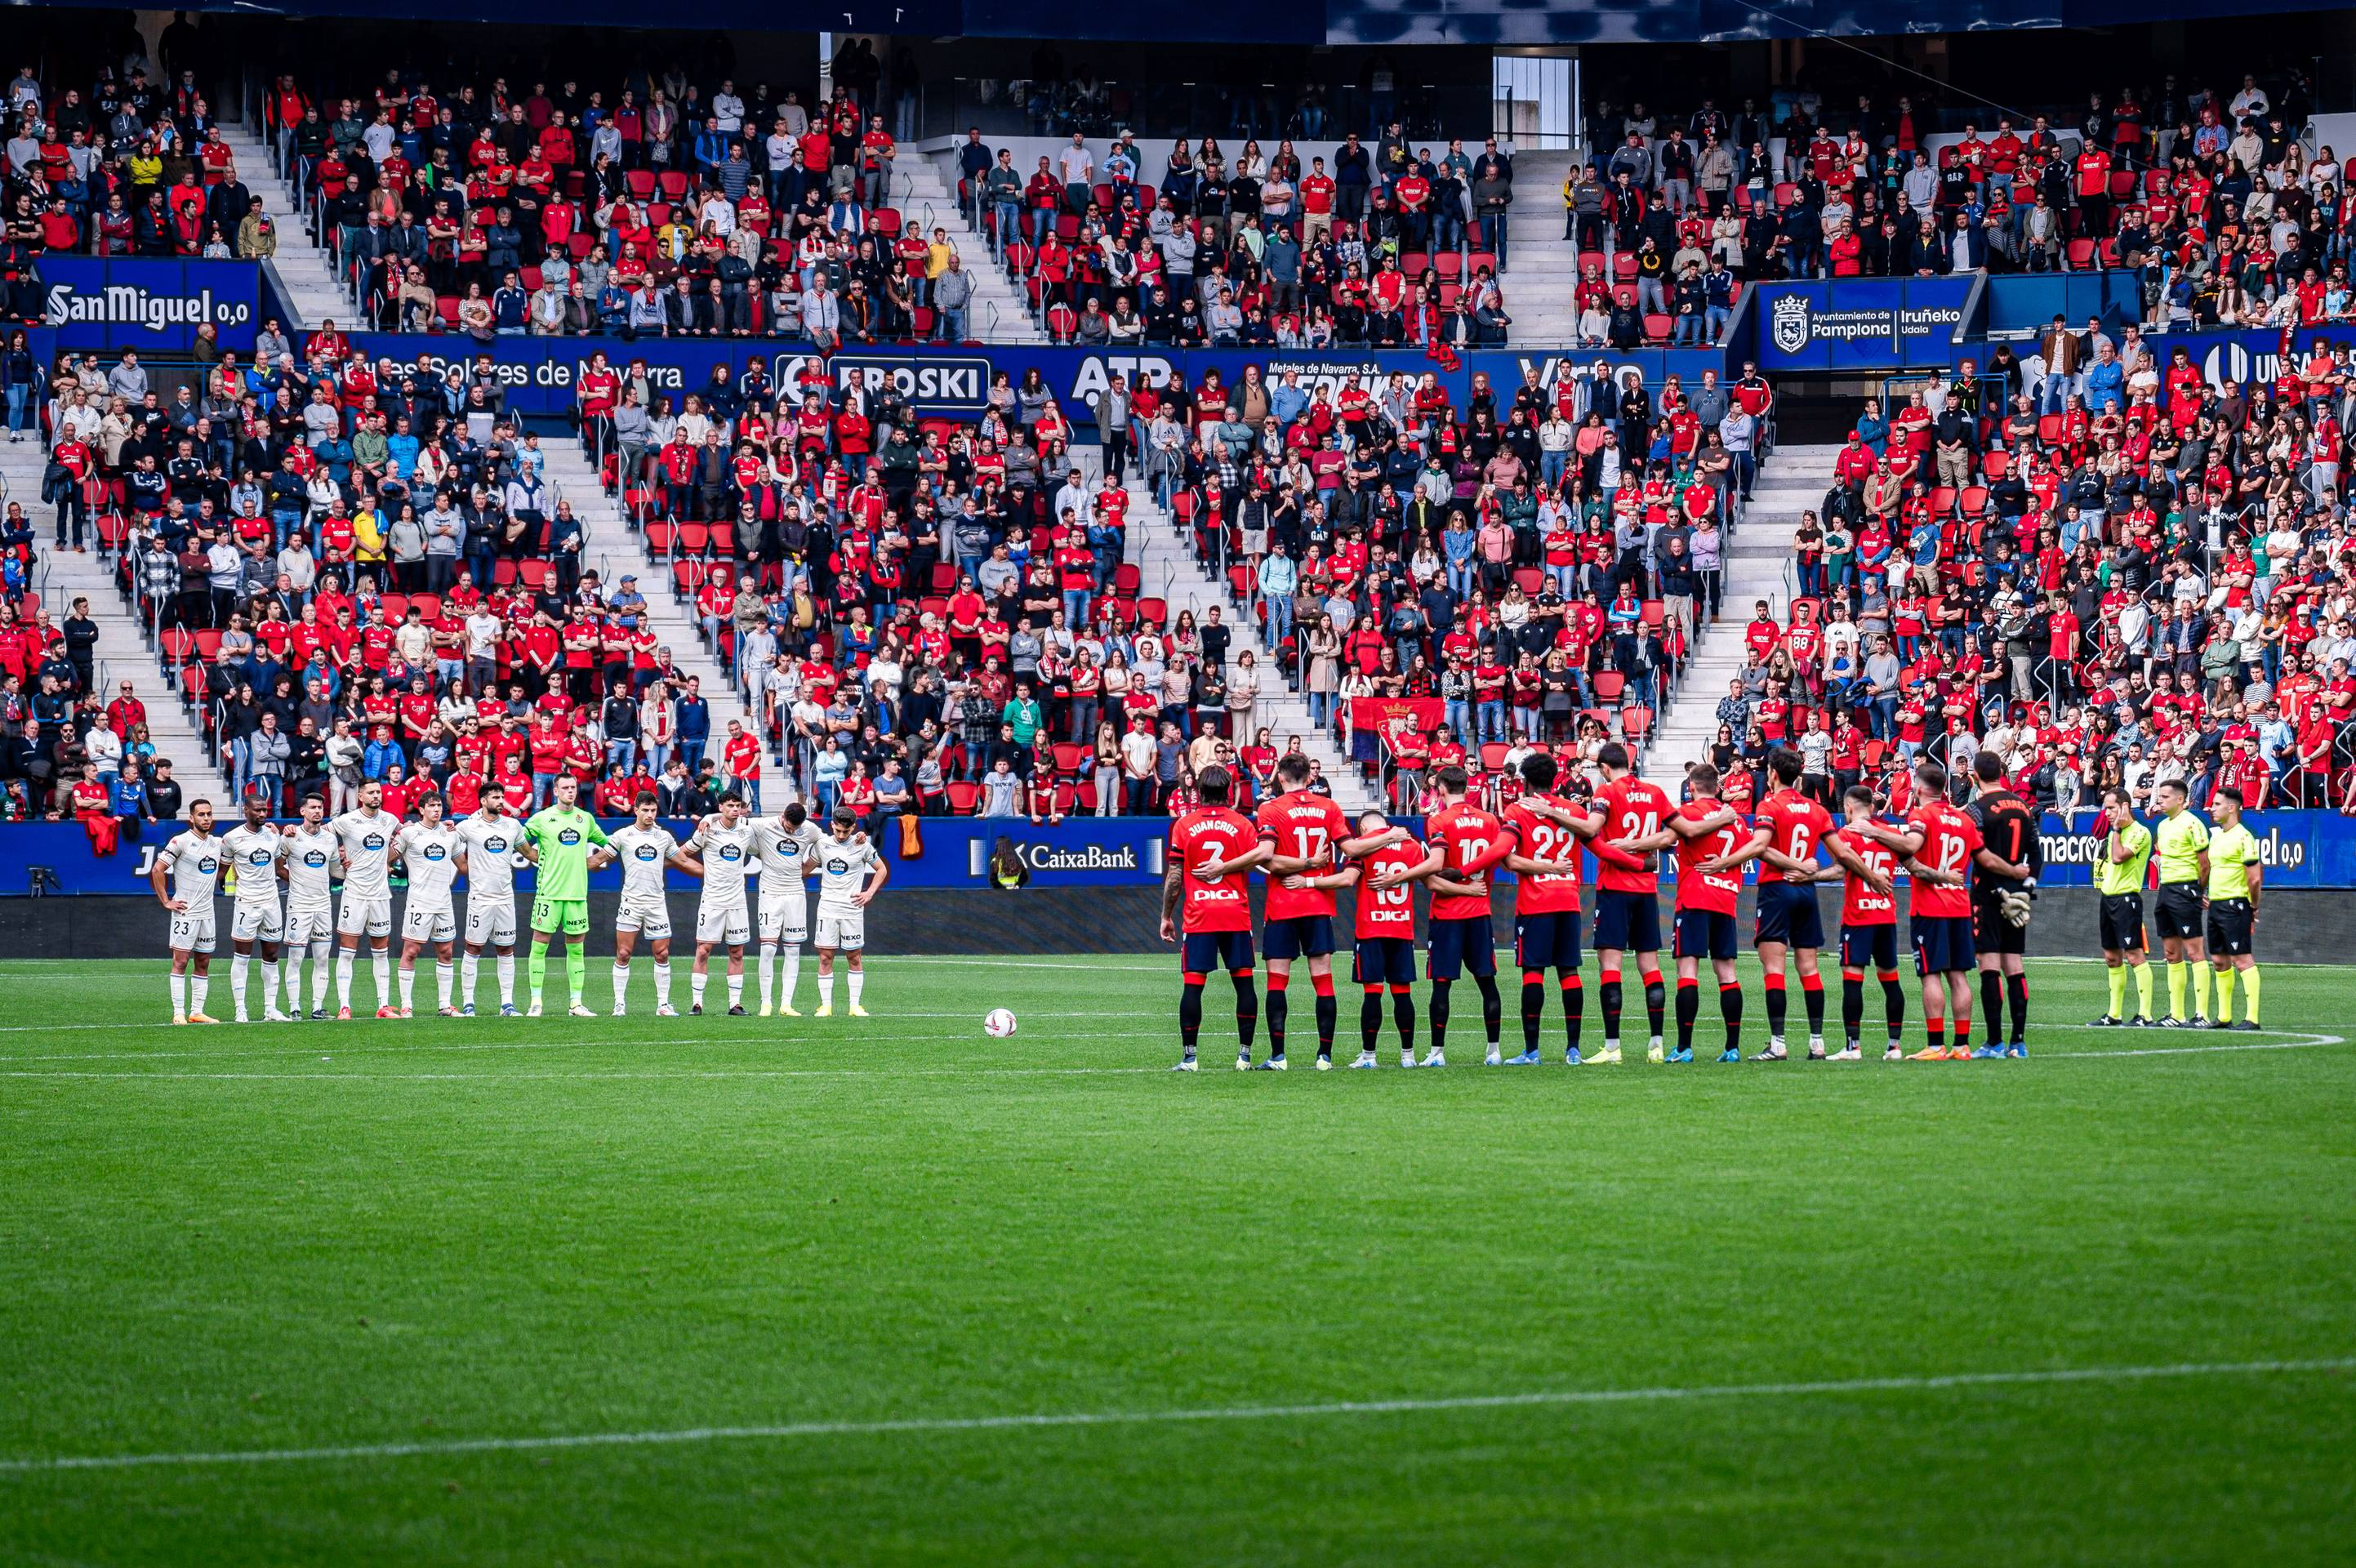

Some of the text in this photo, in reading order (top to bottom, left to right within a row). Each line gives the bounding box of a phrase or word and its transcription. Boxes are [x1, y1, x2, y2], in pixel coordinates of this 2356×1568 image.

[1947, 173, 1963, 182] GAP
[1812, 311, 1890, 323] Ayuntamiento de
[1901, 309, 1960, 323] Iruñeko
[1812, 323, 1891, 340] Pamplona
[536, 360, 569, 385] de
[1269, 363, 1380, 375] Metales de Navarra, S.A.
[1072, 357, 1172, 398] ATP
[1793, 636, 1808, 650] 88
[1288, 807, 1326, 819] BUDIMIR
[1623, 812, 1657, 846] 24
[1293, 826, 1327, 862] 17
[1532, 826, 1574, 864] 22
[1789, 823, 1810, 862] 6
[2009, 818, 2021, 862] 1
[1717, 830, 1735, 866] 7
[1940, 833, 1965, 875] 12
[1031, 845, 1136, 868] CaixaBank
[1459, 839, 1490, 880] 10
[1373, 862, 1409, 905] 19
[1704, 875, 1739, 893] DIGI
[1194, 890, 1239, 901] DIGI
[537, 903, 549, 916] 13
[1859, 898, 1891, 910] DIGI
[239, 912, 245, 924] 7
[343, 906, 350, 919] 5
[410, 912, 421, 926] 12
[759, 913, 768, 925] 21
[1371, 910, 1410, 921] DIGI
[174, 920, 189, 934] 23
[291, 917, 297, 930] 2
[469, 914, 479, 928] 15
[699, 914, 705, 926] 3
